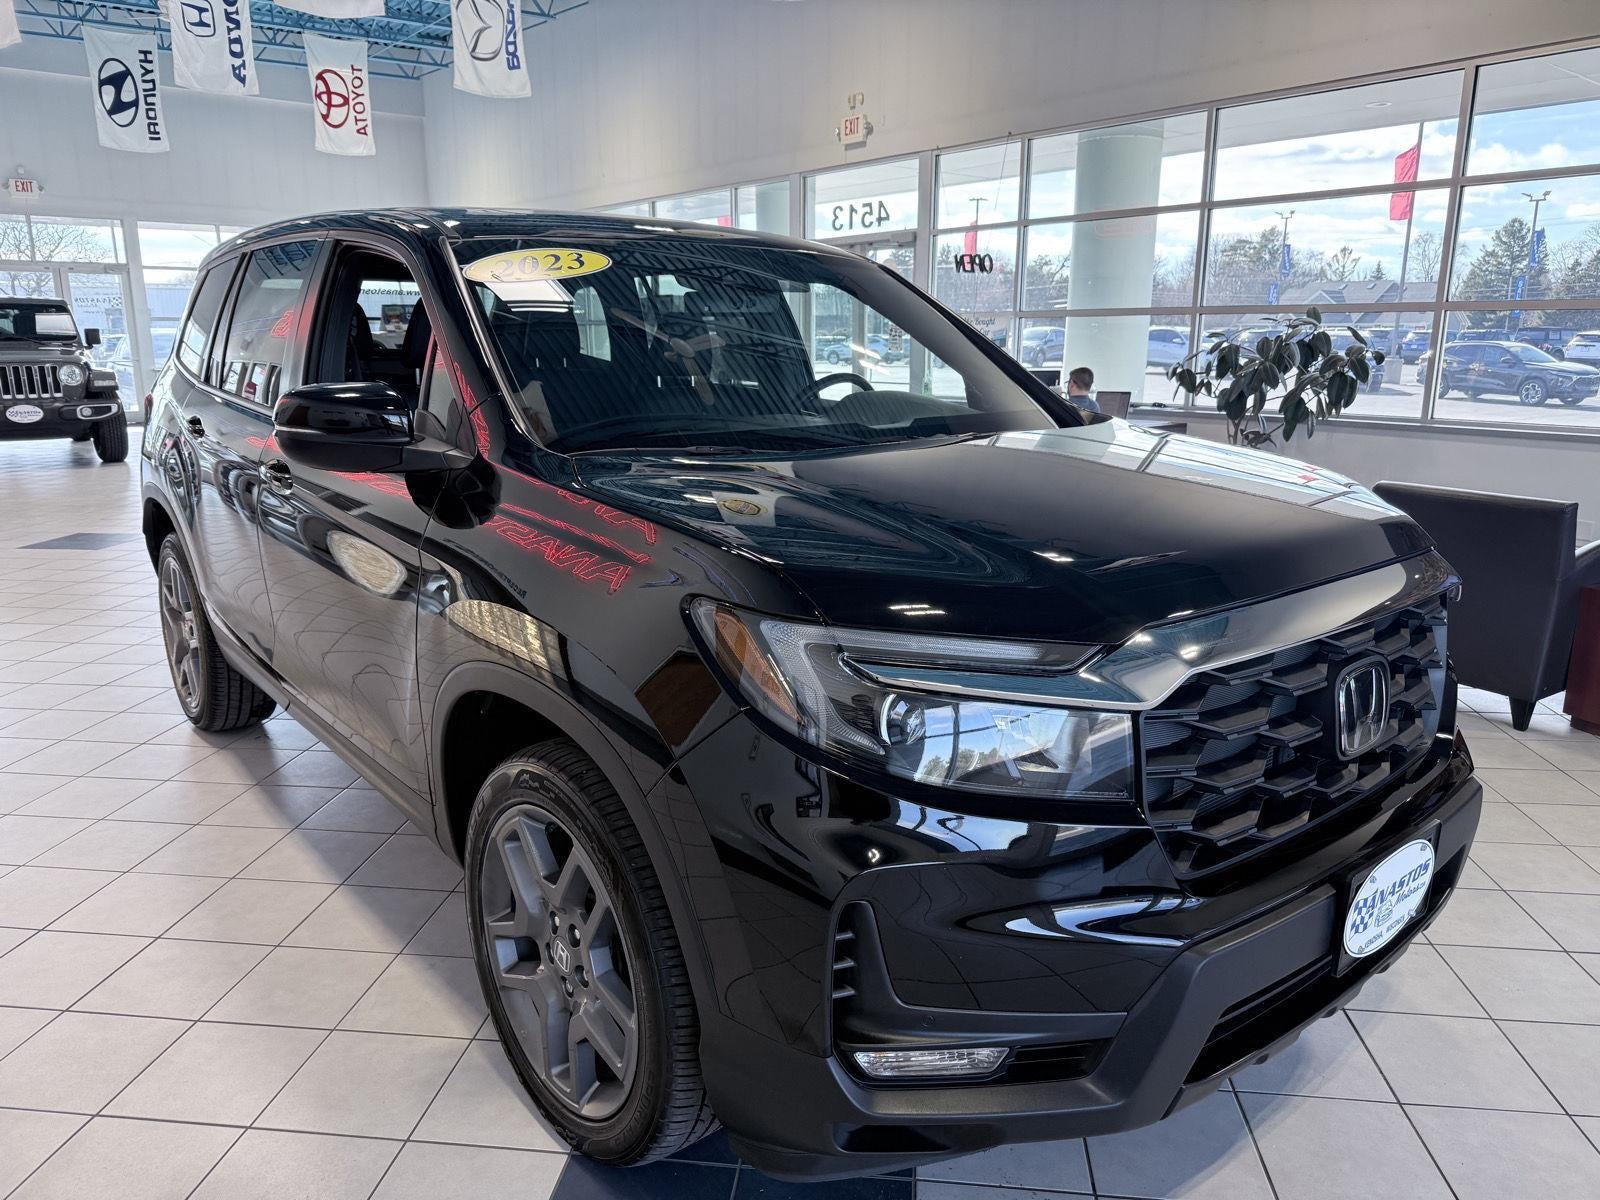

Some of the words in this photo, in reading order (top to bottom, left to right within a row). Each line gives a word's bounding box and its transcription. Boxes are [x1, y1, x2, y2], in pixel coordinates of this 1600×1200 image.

[844, 116, 860, 137] EXIT
[14, 180, 34, 193] EXIT
[494, 252, 586, 277] 2023
[1364, 857, 1432, 916] ANASTOS
